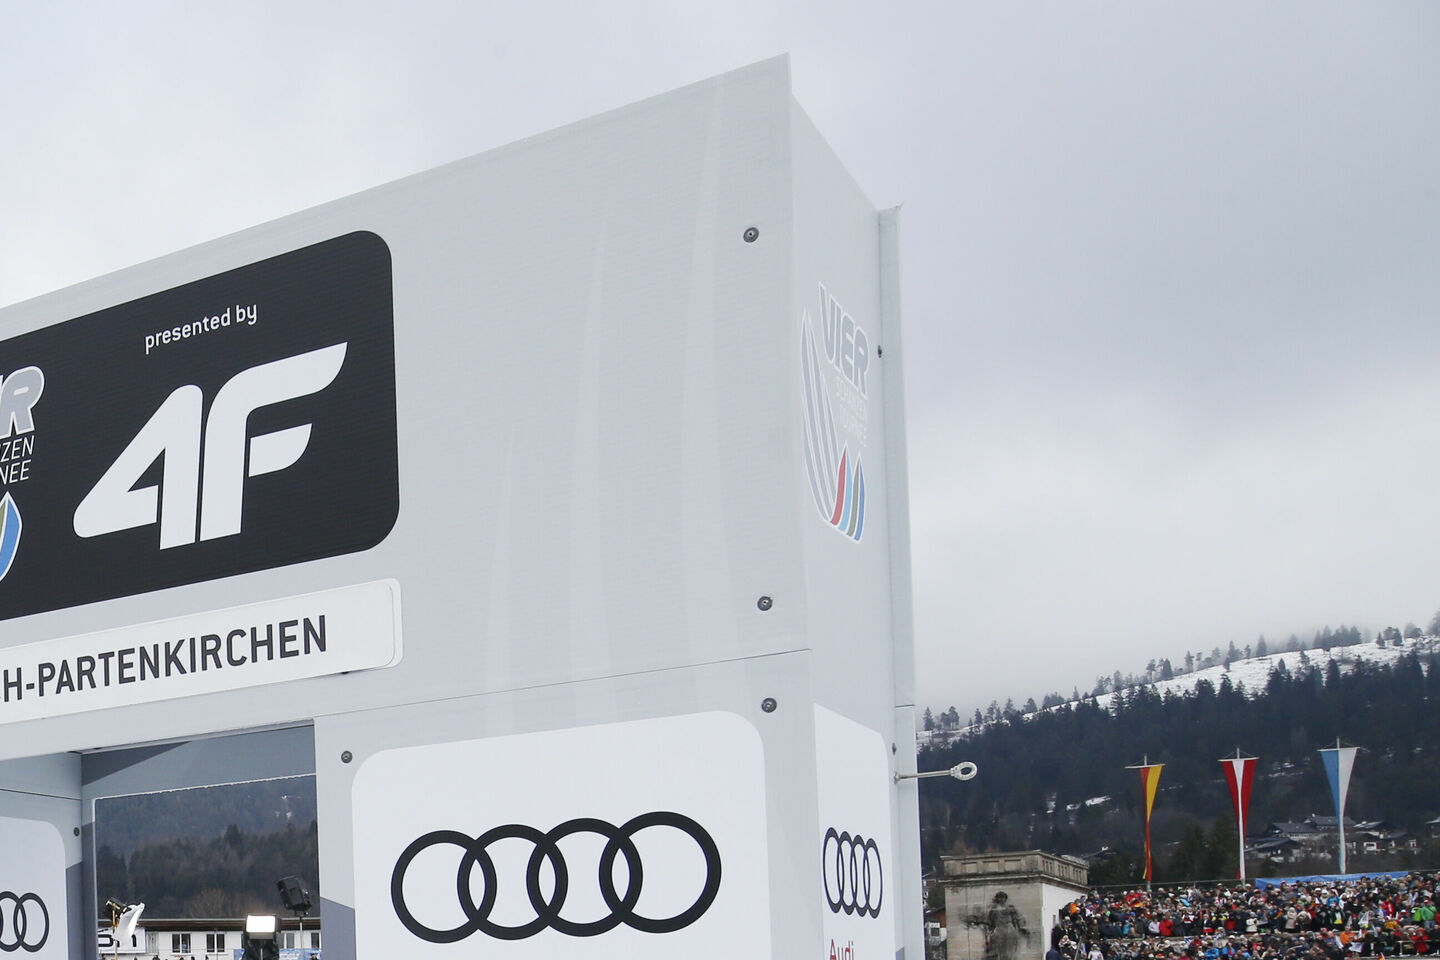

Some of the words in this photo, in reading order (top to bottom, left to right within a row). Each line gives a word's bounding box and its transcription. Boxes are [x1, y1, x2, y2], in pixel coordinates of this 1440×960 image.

[145, 307, 231, 355] presented
[235, 304, 258, 326] by
[73, 341, 348, 551] 4F
